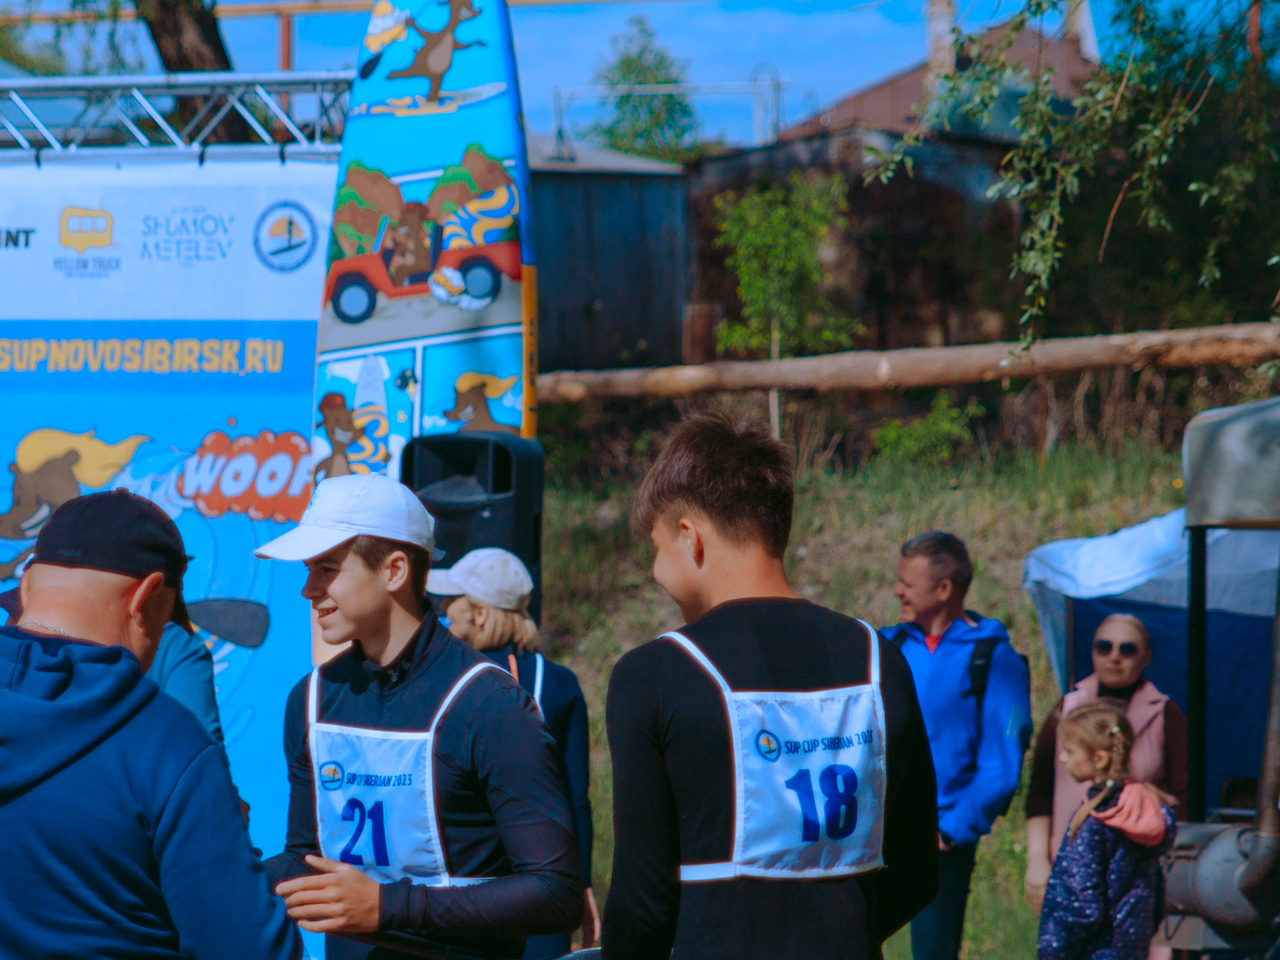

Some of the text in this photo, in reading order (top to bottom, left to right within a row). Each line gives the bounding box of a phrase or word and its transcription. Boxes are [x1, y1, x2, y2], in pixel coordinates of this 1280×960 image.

[785, 741, 801, 754] SUP
[803, 739, 819, 753] CUP
[393, 774, 412, 786] 2023
[784, 763, 859, 843] 18
[339, 797, 391, 867] 21
